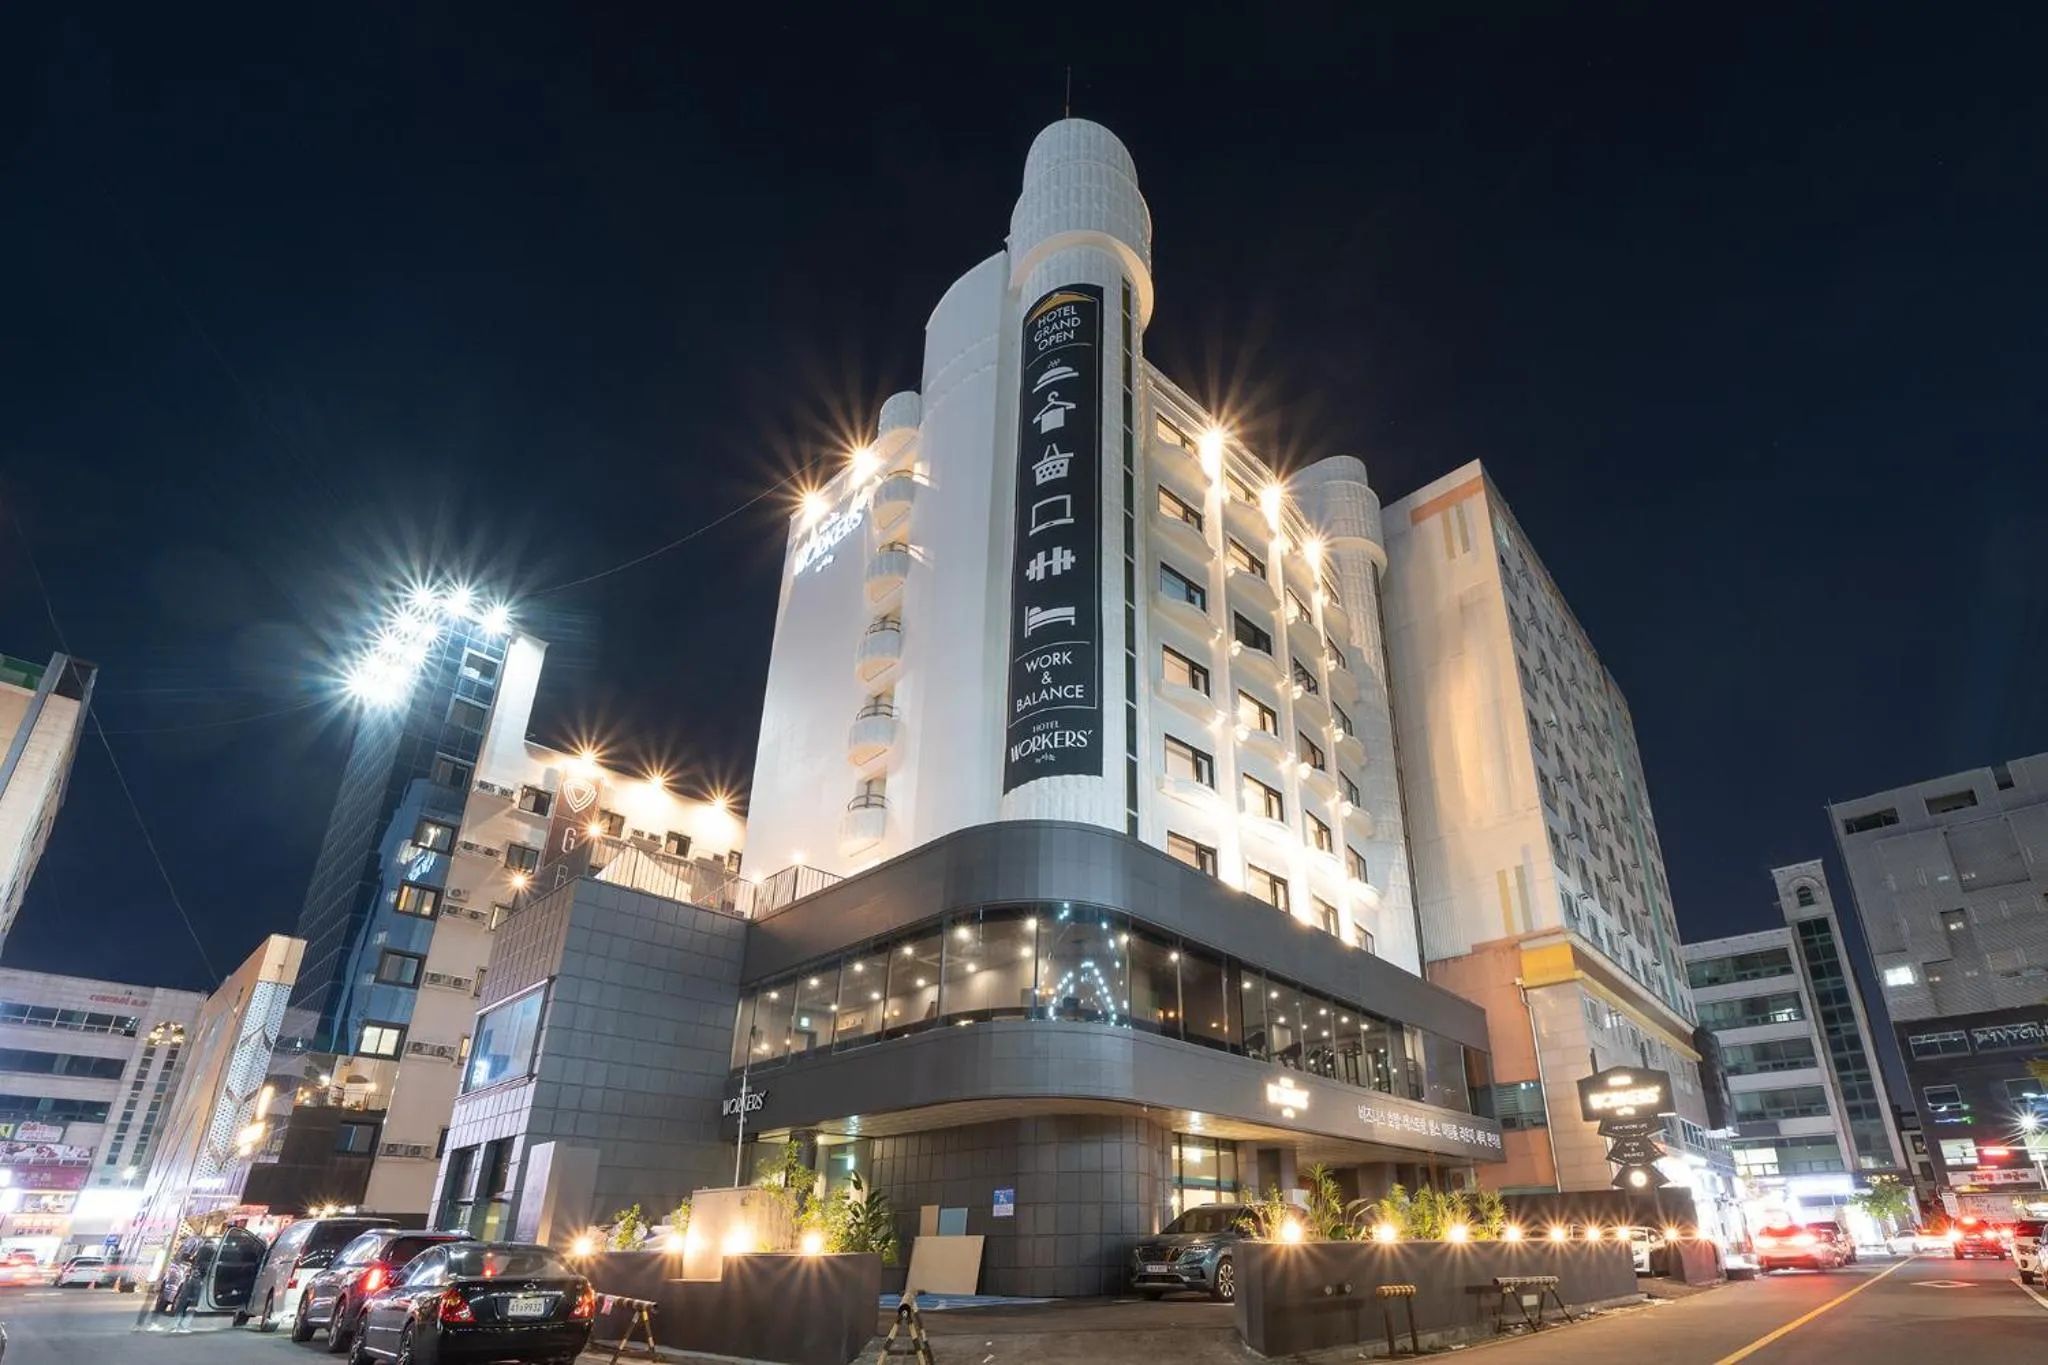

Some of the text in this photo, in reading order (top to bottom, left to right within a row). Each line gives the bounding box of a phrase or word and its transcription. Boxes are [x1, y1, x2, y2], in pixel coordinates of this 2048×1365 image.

[1038, 305, 1077, 328] HOTEL
[1034, 317, 1081, 342] GRAND
[1038, 329, 1074, 351] OPEN
[1025, 651, 1072, 673] WORK
[1041, 670, 1052, 685] &
[1016, 684, 1085, 713] BALANCE
